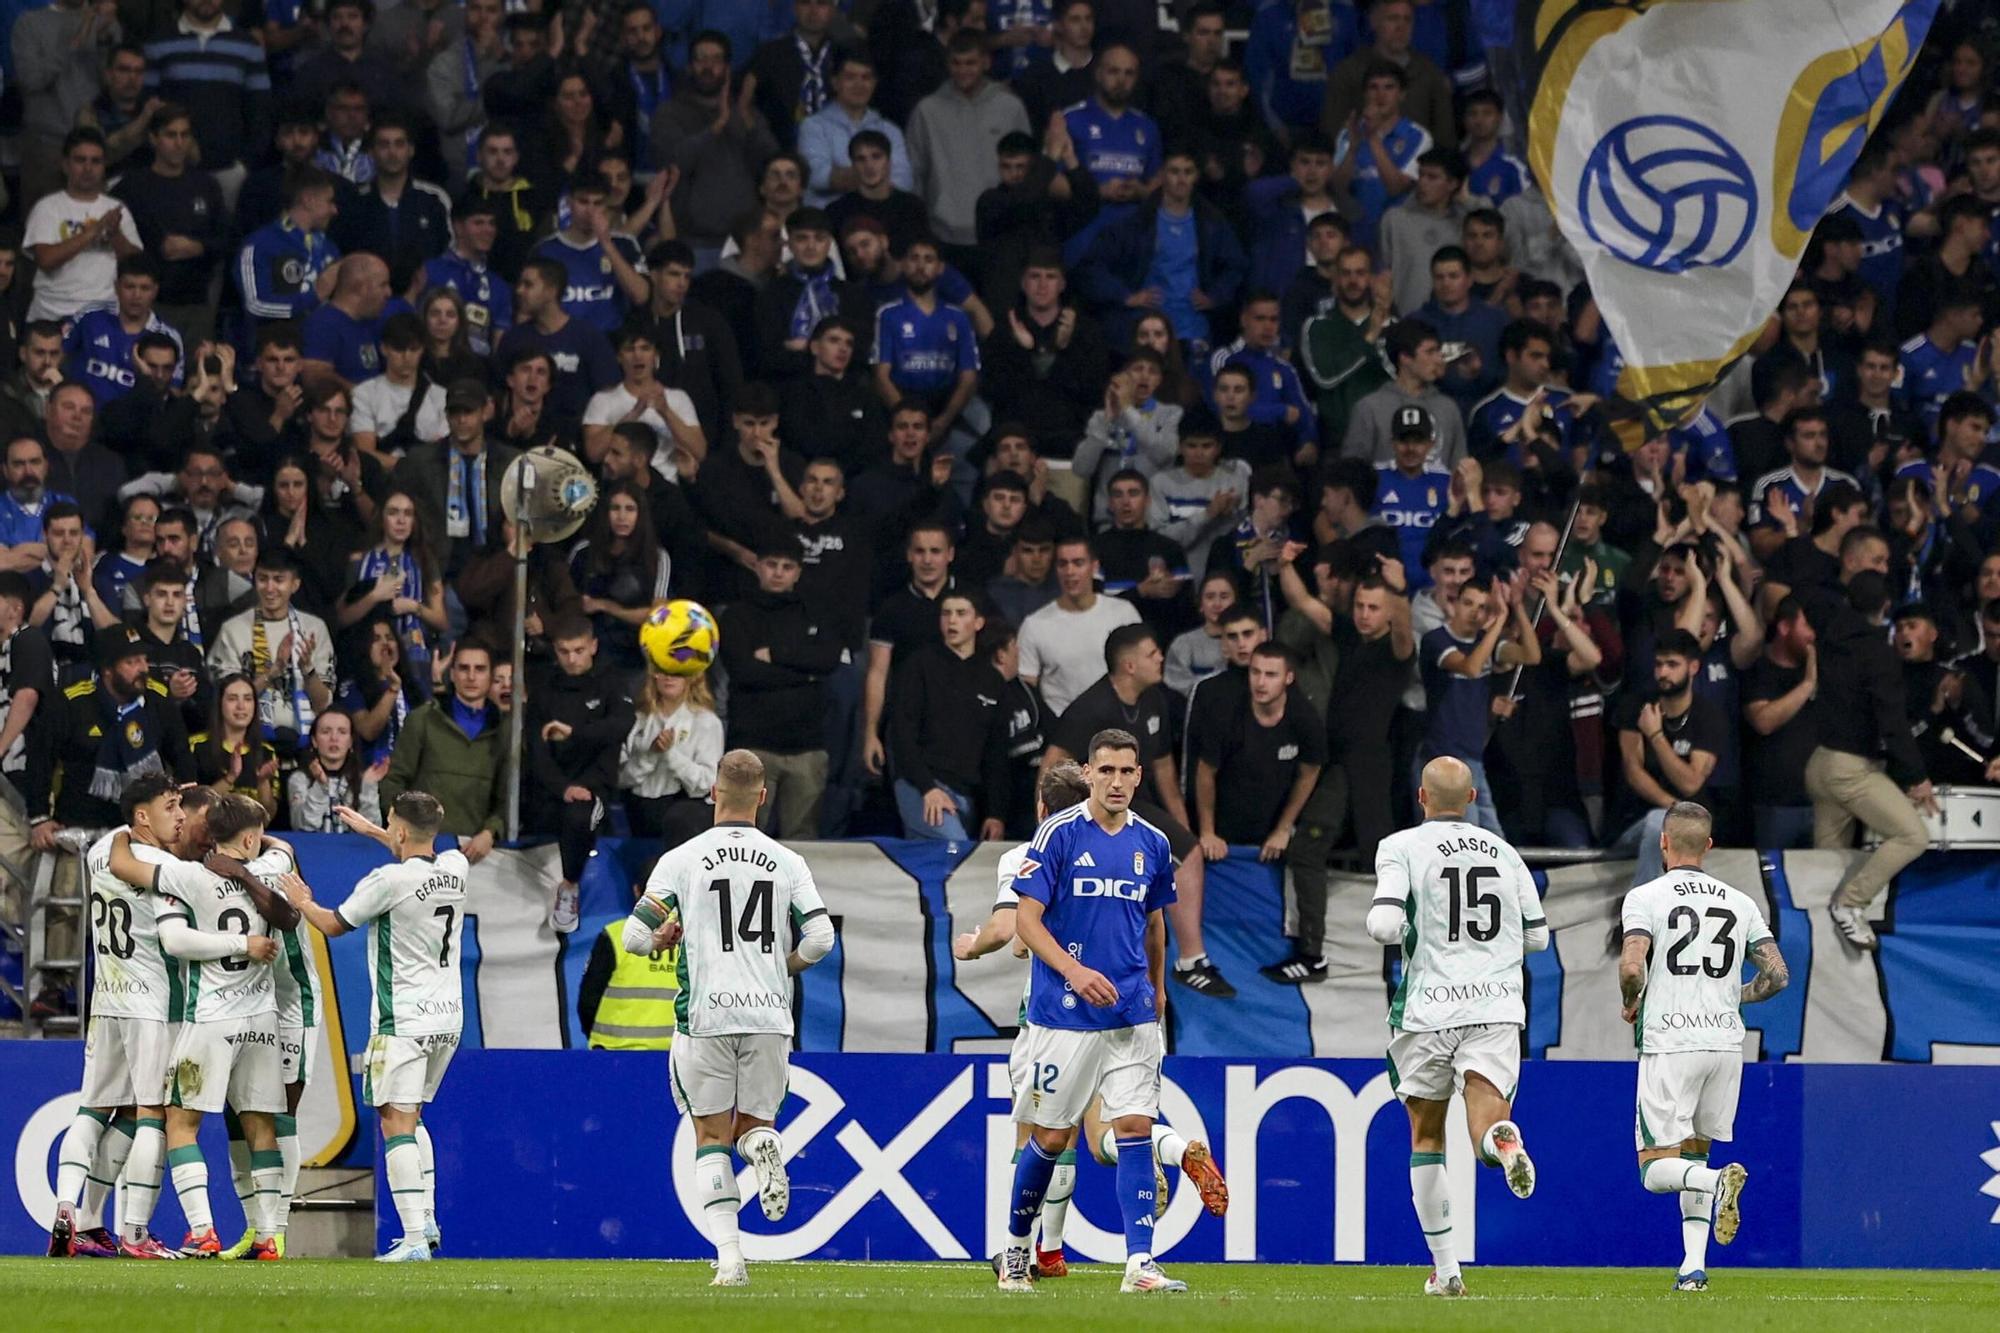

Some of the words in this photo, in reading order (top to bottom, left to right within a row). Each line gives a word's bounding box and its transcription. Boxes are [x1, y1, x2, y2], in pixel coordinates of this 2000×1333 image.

[86, 358, 136, 389] DIG
[1380, 509, 1437, 529] DIG
[702, 847, 777, 873] J.PULIDO
[1437, 838, 1498, 859] BLASCO
[415, 875, 459, 901] GERARD
[1073, 877, 1147, 903] DIGI
[1674, 881, 1727, 900] SIELVA
[708, 878, 775, 954] 14
[1440, 867, 1501, 942] 15
[433, 904, 456, 969] 7
[1667, 905, 1738, 979] 23
[708, 991, 789, 1011] SOMMOS
[1424, 981, 1510, 1005] SOMMOS
[1661, 1011, 1738, 1030] SOMMOS
[1033, 1061, 1059, 1094] 12
[1138, 1190, 1153, 1200] RO
